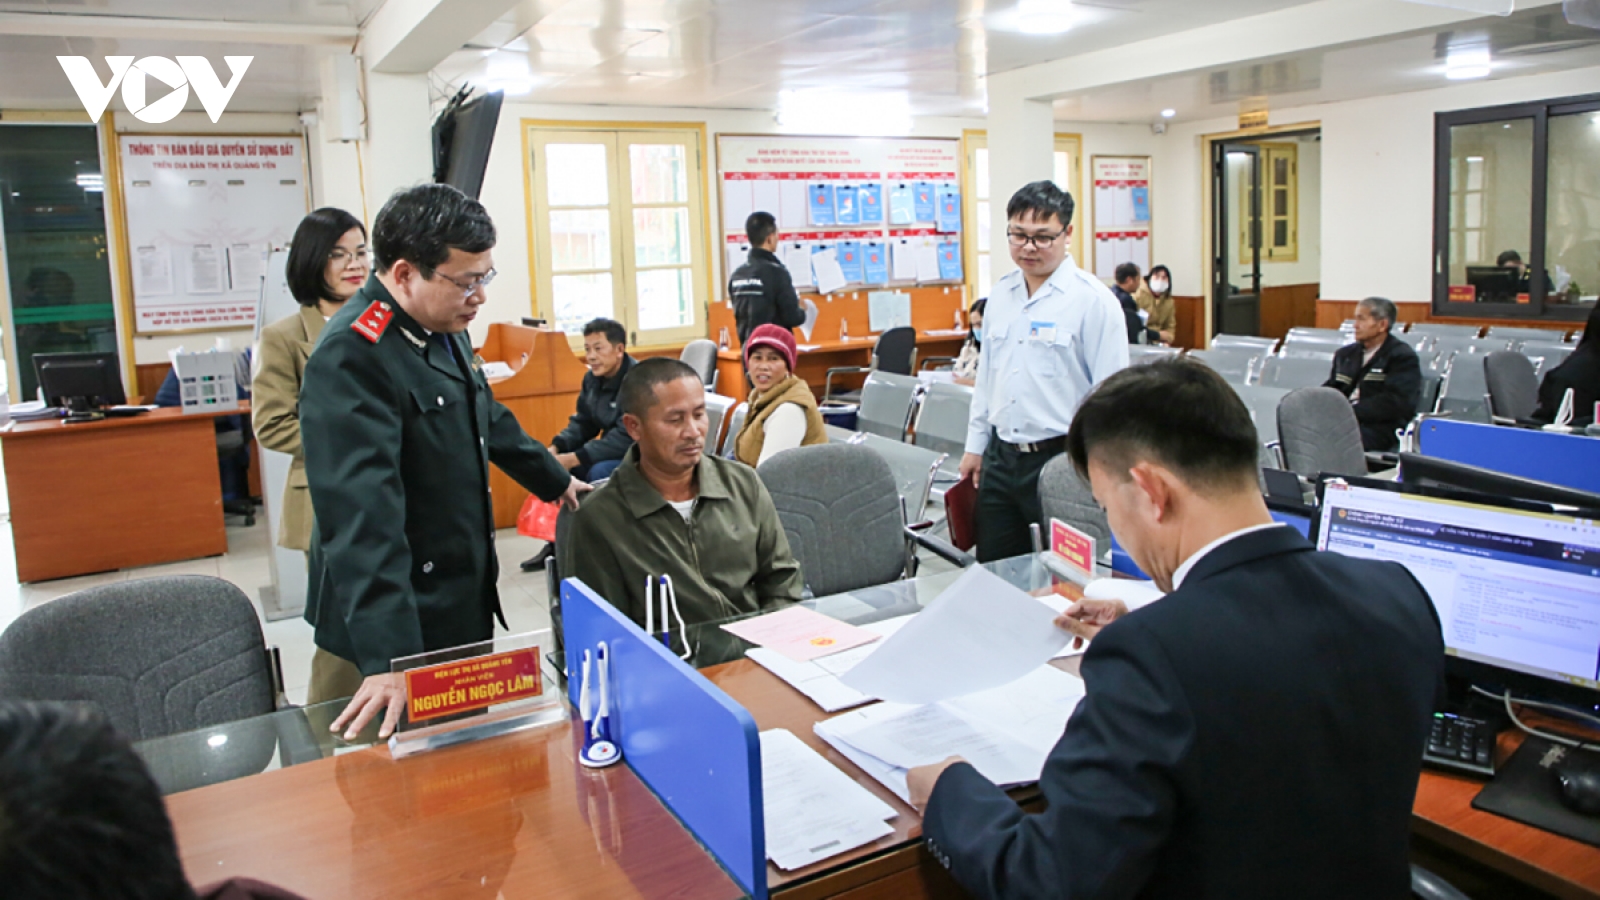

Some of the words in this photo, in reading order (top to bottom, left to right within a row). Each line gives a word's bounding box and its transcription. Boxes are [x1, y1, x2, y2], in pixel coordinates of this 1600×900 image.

[128, 141, 155, 156] THÔNG
[156, 143, 169, 156] TIN
[171, 142, 187, 156] BÁN
[189, 140, 204, 156] ĐẤU
[206, 142, 219, 156] GIÁ
[221, 141, 245, 157] QUYỀN
[247, 140, 257, 156] SỬ
[259, 144, 279, 158] DỤNG
[280, 141, 294, 156] ĐẤT
[153, 160, 172, 169] TRÊN
[189, 160, 205, 169] BÀN
[207, 161, 219, 171] THỊ
[221, 160, 232, 169] XÃ
[233, 160, 260, 170] QUẢNG
[262, 160, 276, 169] YÊN
[434, 670, 449, 679] ĐIỆN
[450, 667, 461, 677] LỰC
[501, 657, 513, 666] YÊN
[455, 675, 477, 685] NHÂN
[478, 671, 495, 682] VIÊN
[413, 686, 466, 713] NGUYỄN
[469, 681, 505, 700] NGỌC
[507, 674, 534, 693] LÂM
